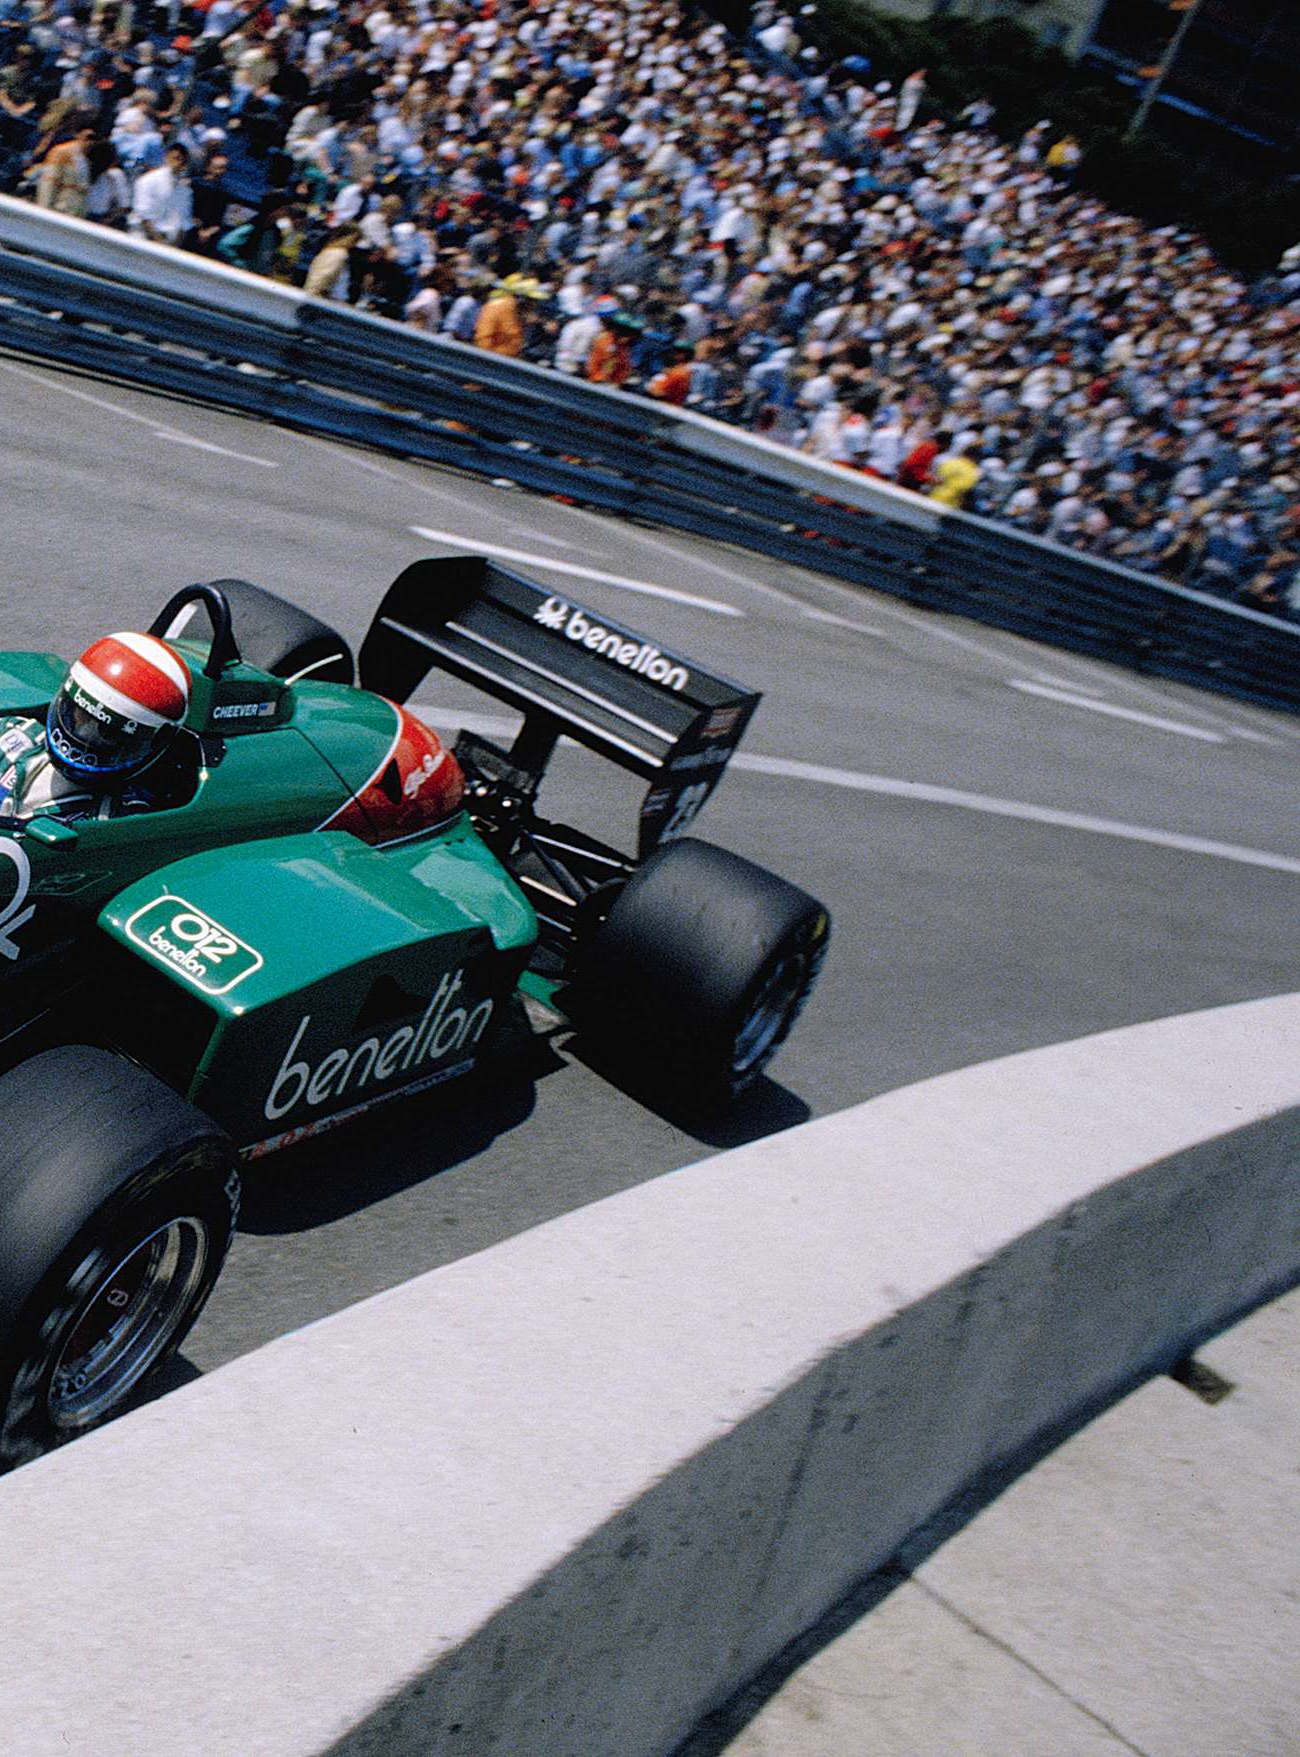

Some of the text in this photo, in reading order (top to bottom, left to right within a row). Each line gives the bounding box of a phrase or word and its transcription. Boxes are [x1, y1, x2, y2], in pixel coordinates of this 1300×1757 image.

[563, 611, 690, 691] benetton
[74, 688, 112, 724] benetton
[213, 704, 258, 719] CHEEVER
[149, 925, 207, 977] benetton
[263, 968, 493, 1121] benetton
